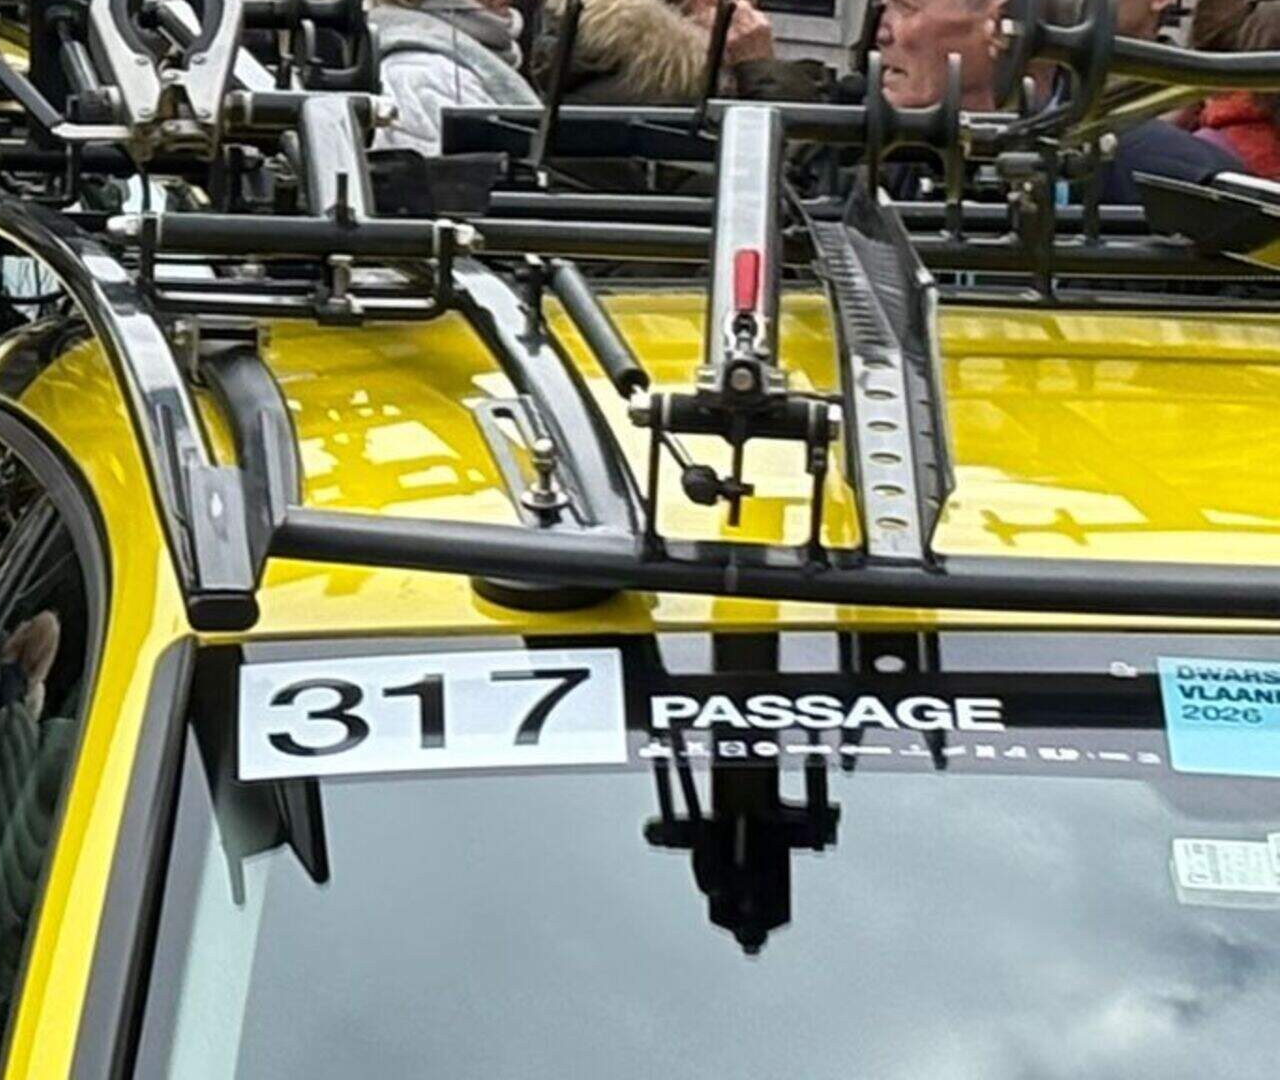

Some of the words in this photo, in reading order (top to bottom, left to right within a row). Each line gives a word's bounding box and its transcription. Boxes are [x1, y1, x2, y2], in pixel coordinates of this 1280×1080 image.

[1178, 684, 1280, 704] VLAAN
[268, 668, 592, 758] 317
[650, 695, 1006, 731] PASSAGE
[1182, 705, 1263, 724] 2026
